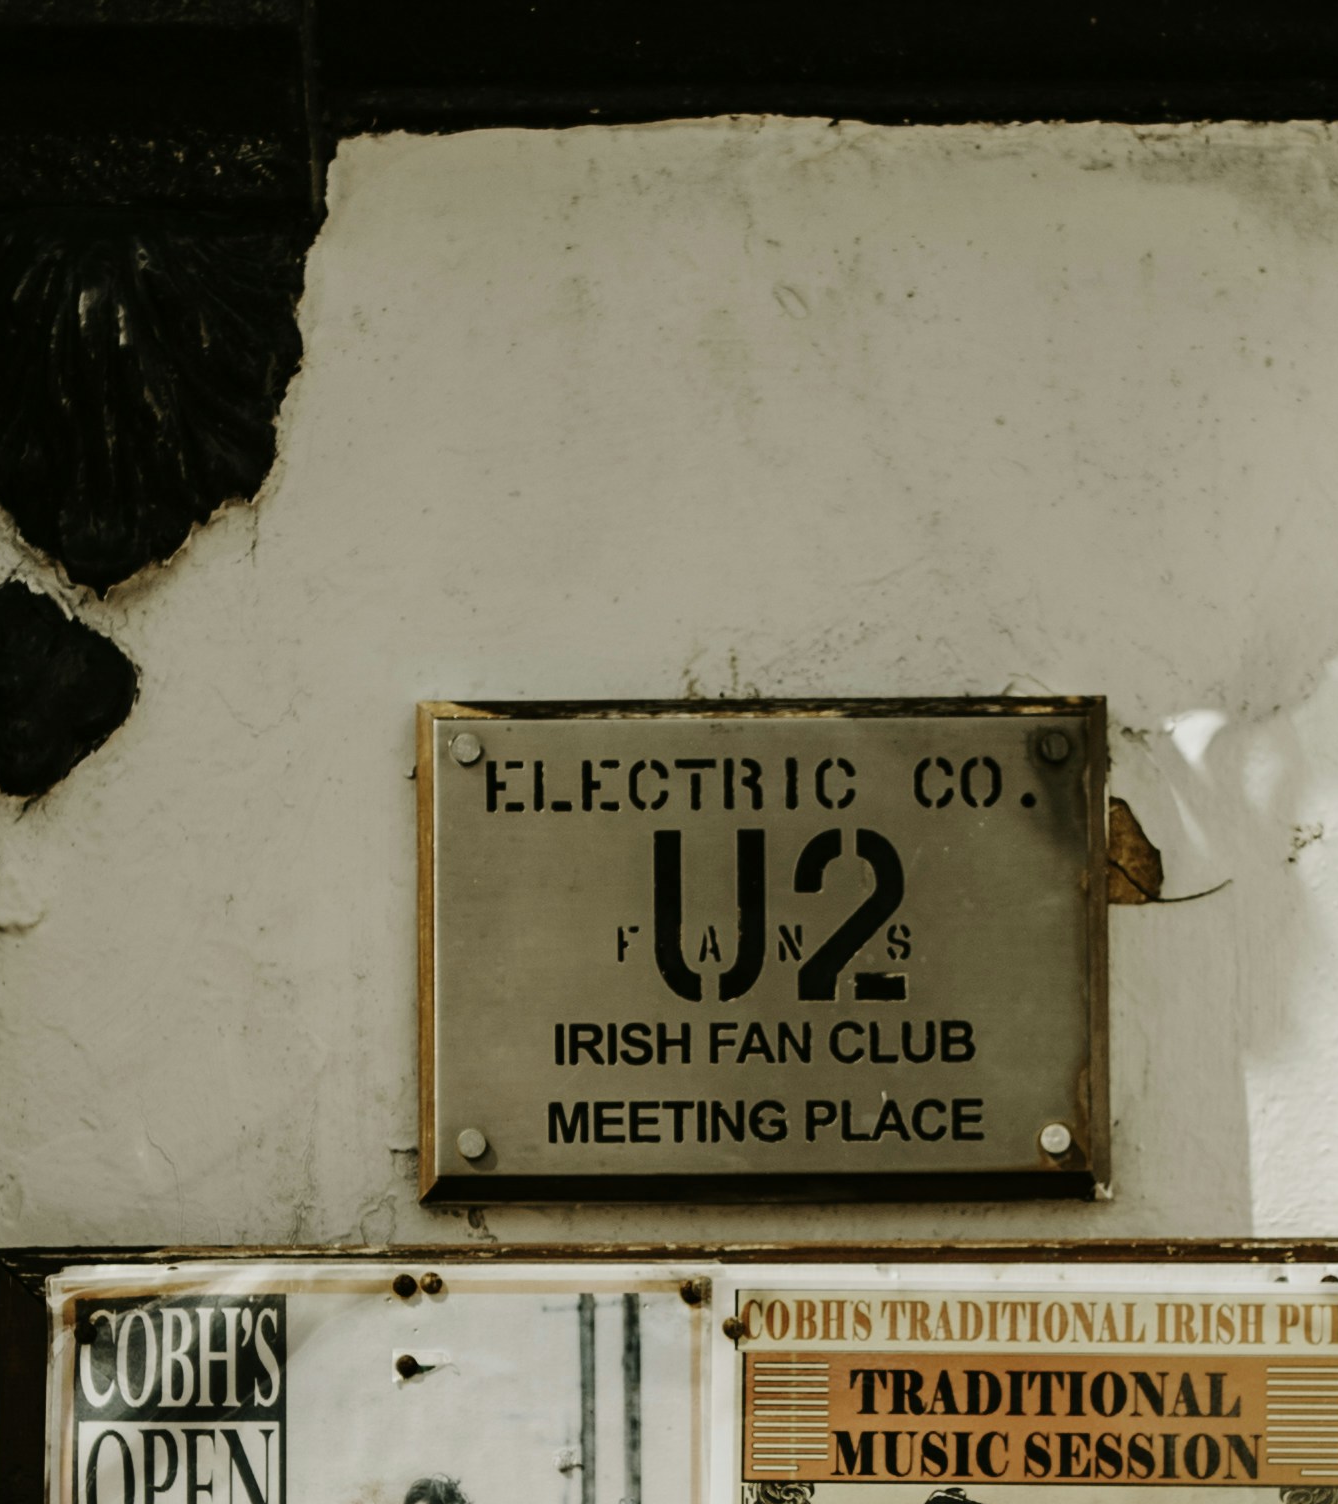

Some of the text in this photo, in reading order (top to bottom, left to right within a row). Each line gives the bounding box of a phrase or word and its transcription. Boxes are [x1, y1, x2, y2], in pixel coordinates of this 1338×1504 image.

[486, 755, 1036, 812] ELECTRIC CO.
[654, 828, 905, 1001] U2
[554, 1020, 976, 1065] IRISH FAN CLUB
[548, 1099, 984, 1144] MEETING PLACE
[740, 1299, 872, 1341] COBH'S
[881, 1300, 1145, 1343] TRADITIONAL
[1154, 1303, 1266, 1344] IRISH
[79, 1307, 280, 1409] COBH'S
[850, 1369, 1241, 1418] TRADITIONAL
[830, 1431, 1262, 1480] MUSIC SESSION
